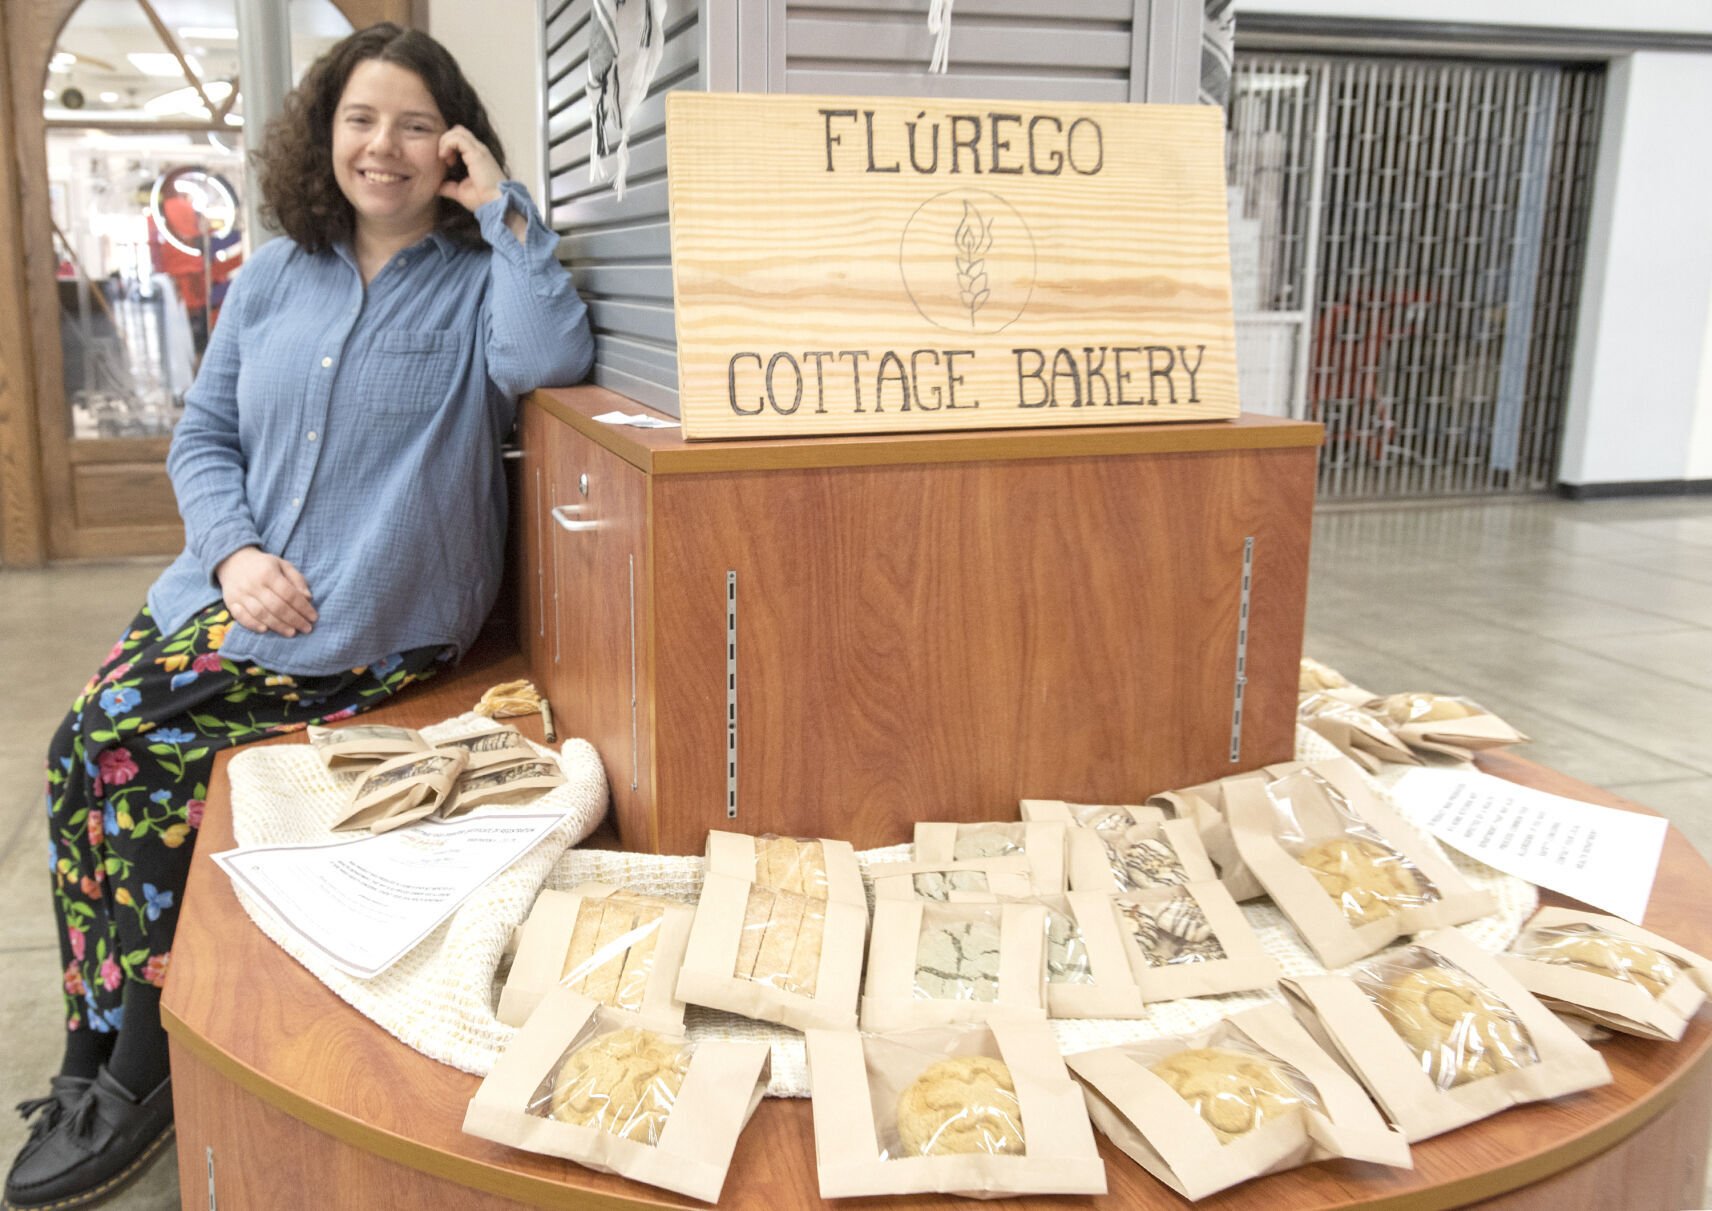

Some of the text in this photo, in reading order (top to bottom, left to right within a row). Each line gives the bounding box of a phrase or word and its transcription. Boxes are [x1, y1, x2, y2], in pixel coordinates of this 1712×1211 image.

[818, 109, 1104, 176] FLÚREGO
[727, 344, 1207, 417] COTTAGE BAKERY
